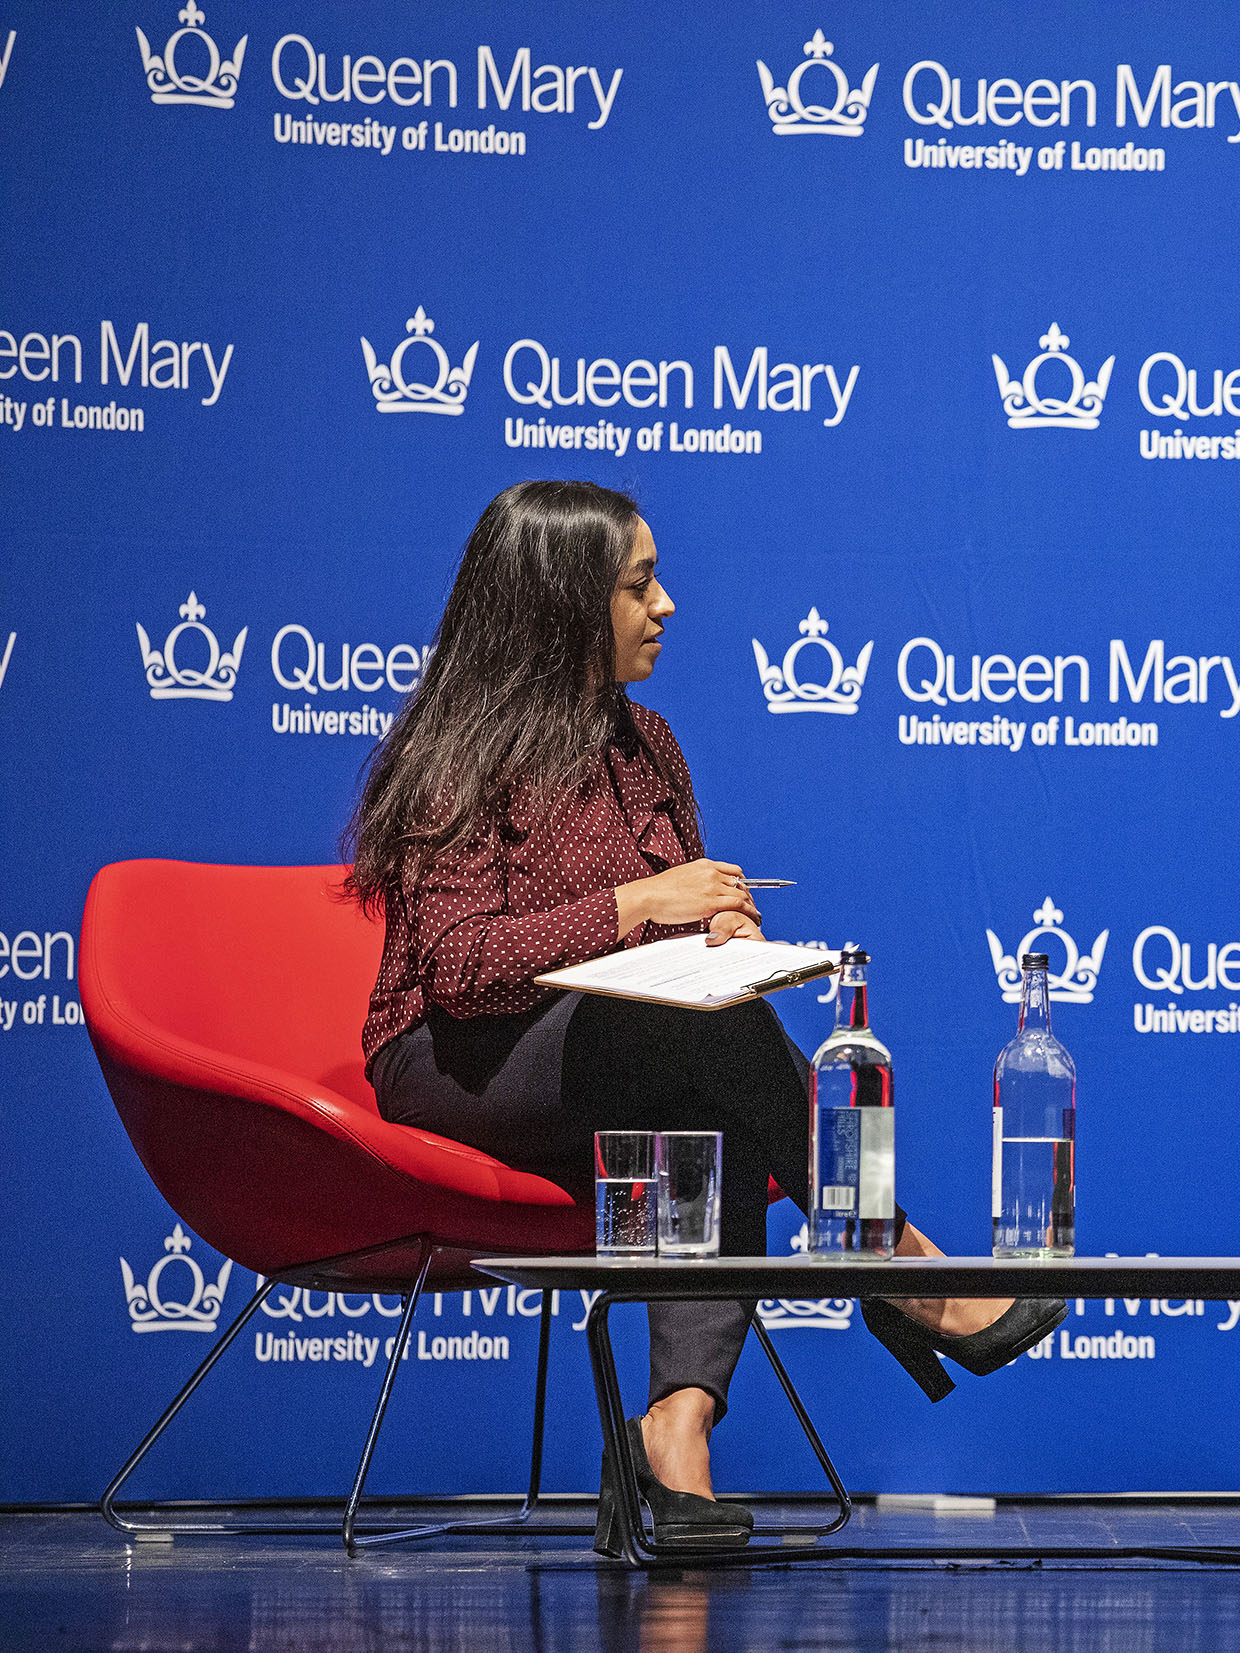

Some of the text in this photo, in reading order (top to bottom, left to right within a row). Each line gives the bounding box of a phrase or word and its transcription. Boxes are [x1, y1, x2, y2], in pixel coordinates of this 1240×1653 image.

[272, 34, 623, 129] Queen Mary
[903, 61, 1096, 129] Queen
[274, 113, 526, 155] University of London
[904, 138, 1165, 176] University of London
[0, 321, 234, 405] een Mary
[504, 339, 860, 427] Queen Mary
[32, 397, 56, 427] of
[62, 399, 144, 431] London
[505, 418, 762, 457] University of London
[272, 624, 437, 694] Quee
[898, 637, 1089, 706] Queen
[899, 714, 1158, 752] University of London
[22, 994, 46, 1025] of
[256, 1331, 379, 1367] University
[418, 1330, 509, 1360] London
[1061, 1330, 1155, 1359] London
